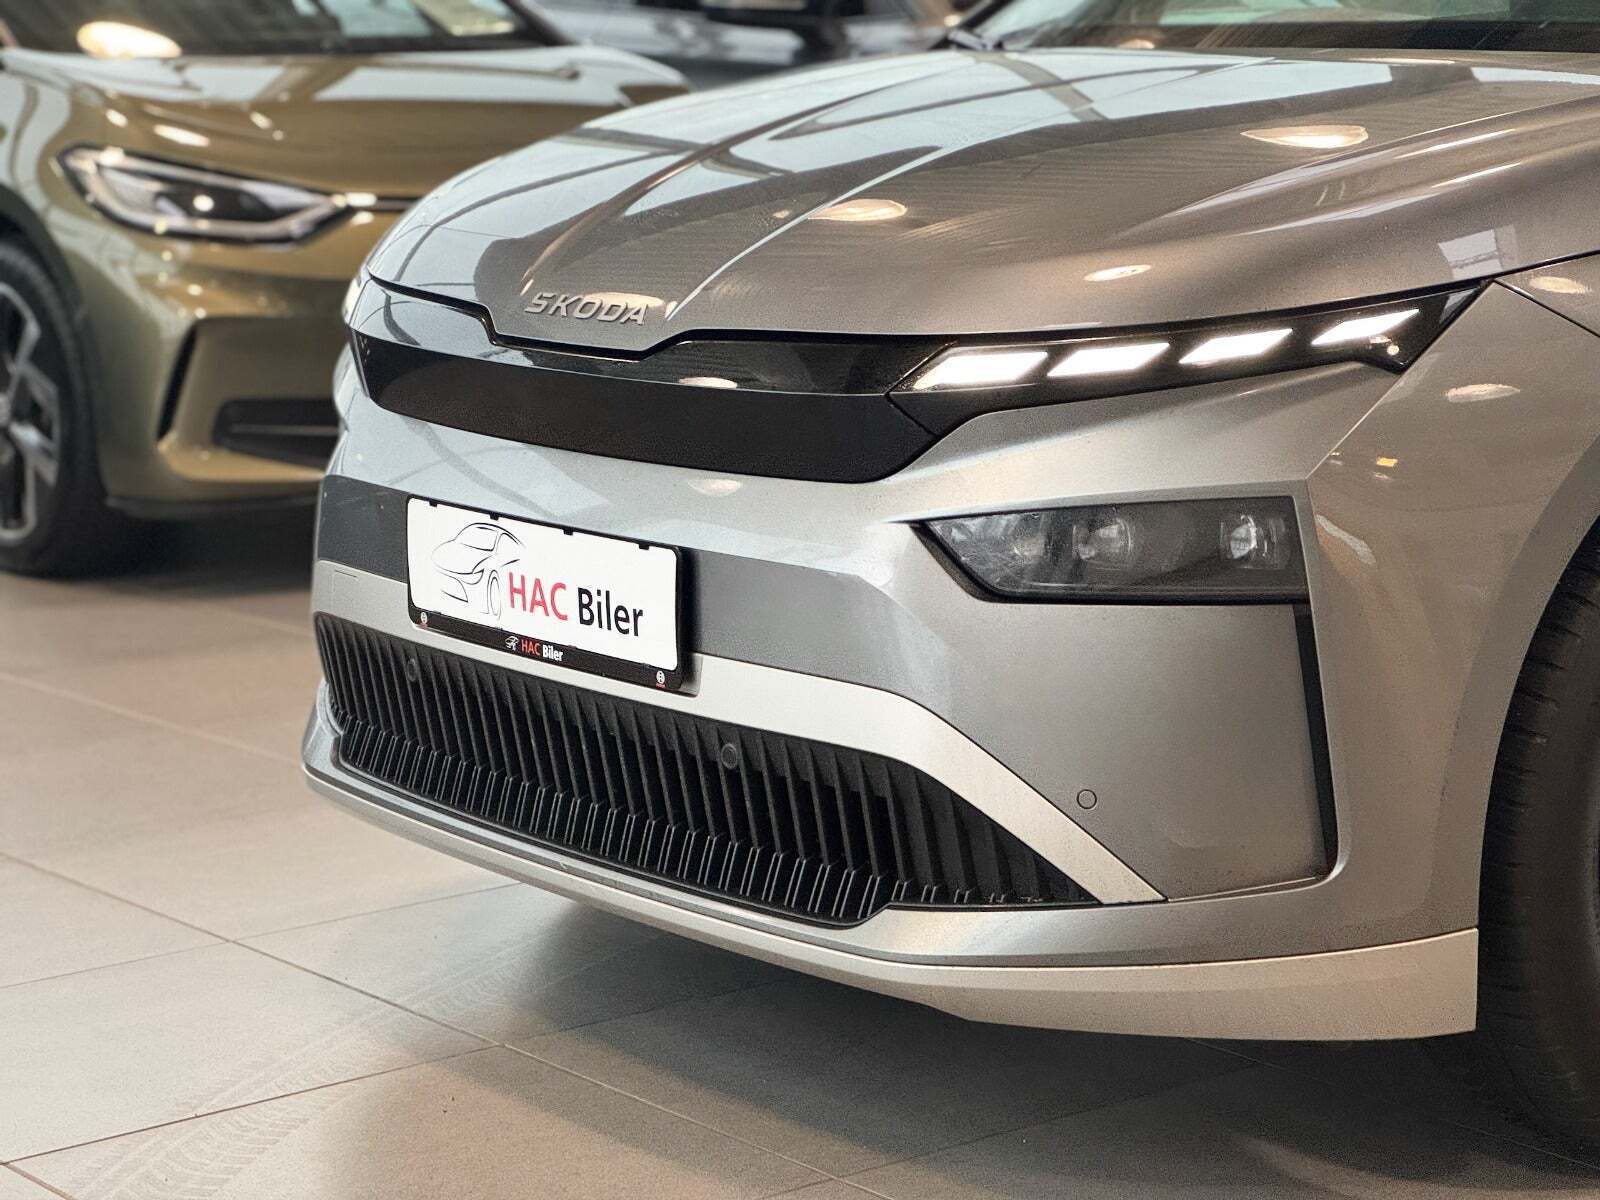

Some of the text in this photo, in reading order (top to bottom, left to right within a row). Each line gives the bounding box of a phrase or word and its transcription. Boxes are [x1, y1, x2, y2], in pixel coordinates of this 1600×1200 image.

[508, 572, 643, 637] HAC Biler
[521, 639, 563, 662] HAC Biler
